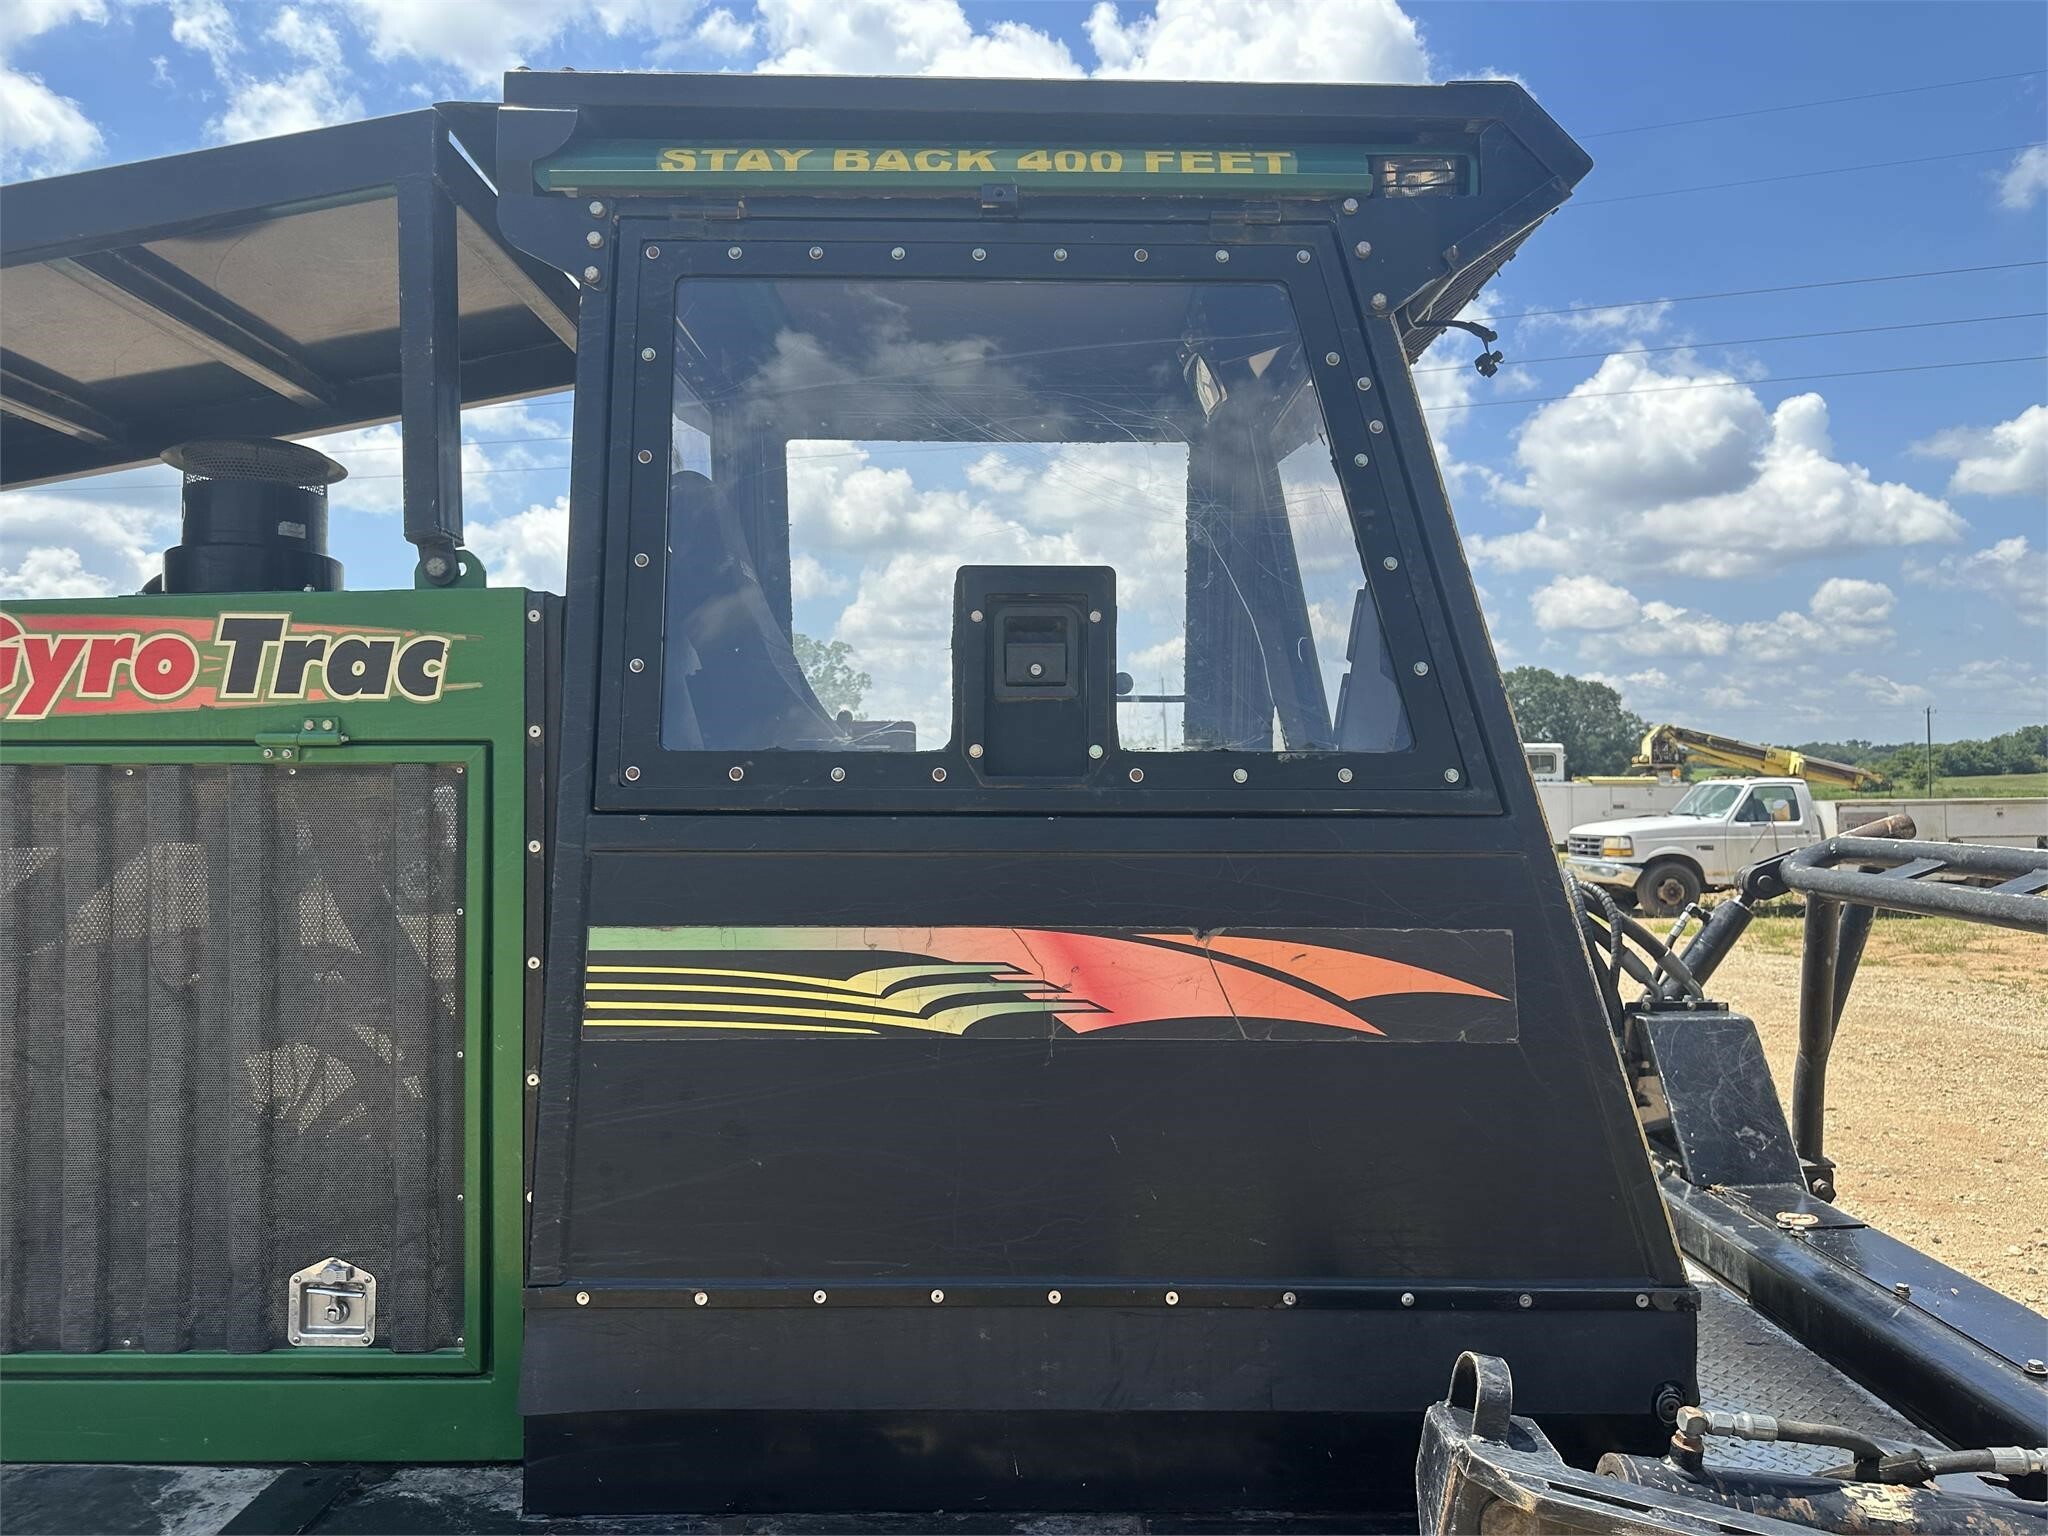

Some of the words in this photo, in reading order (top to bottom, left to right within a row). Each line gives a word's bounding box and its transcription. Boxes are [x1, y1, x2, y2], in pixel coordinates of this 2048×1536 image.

[660, 149, 815, 172] STAY
[832, 149, 998, 172] BACK
[1017, 150, 1123, 173] 400
[1145, 151, 1292, 174] FEET
[215, 613, 450, 702] Trac
